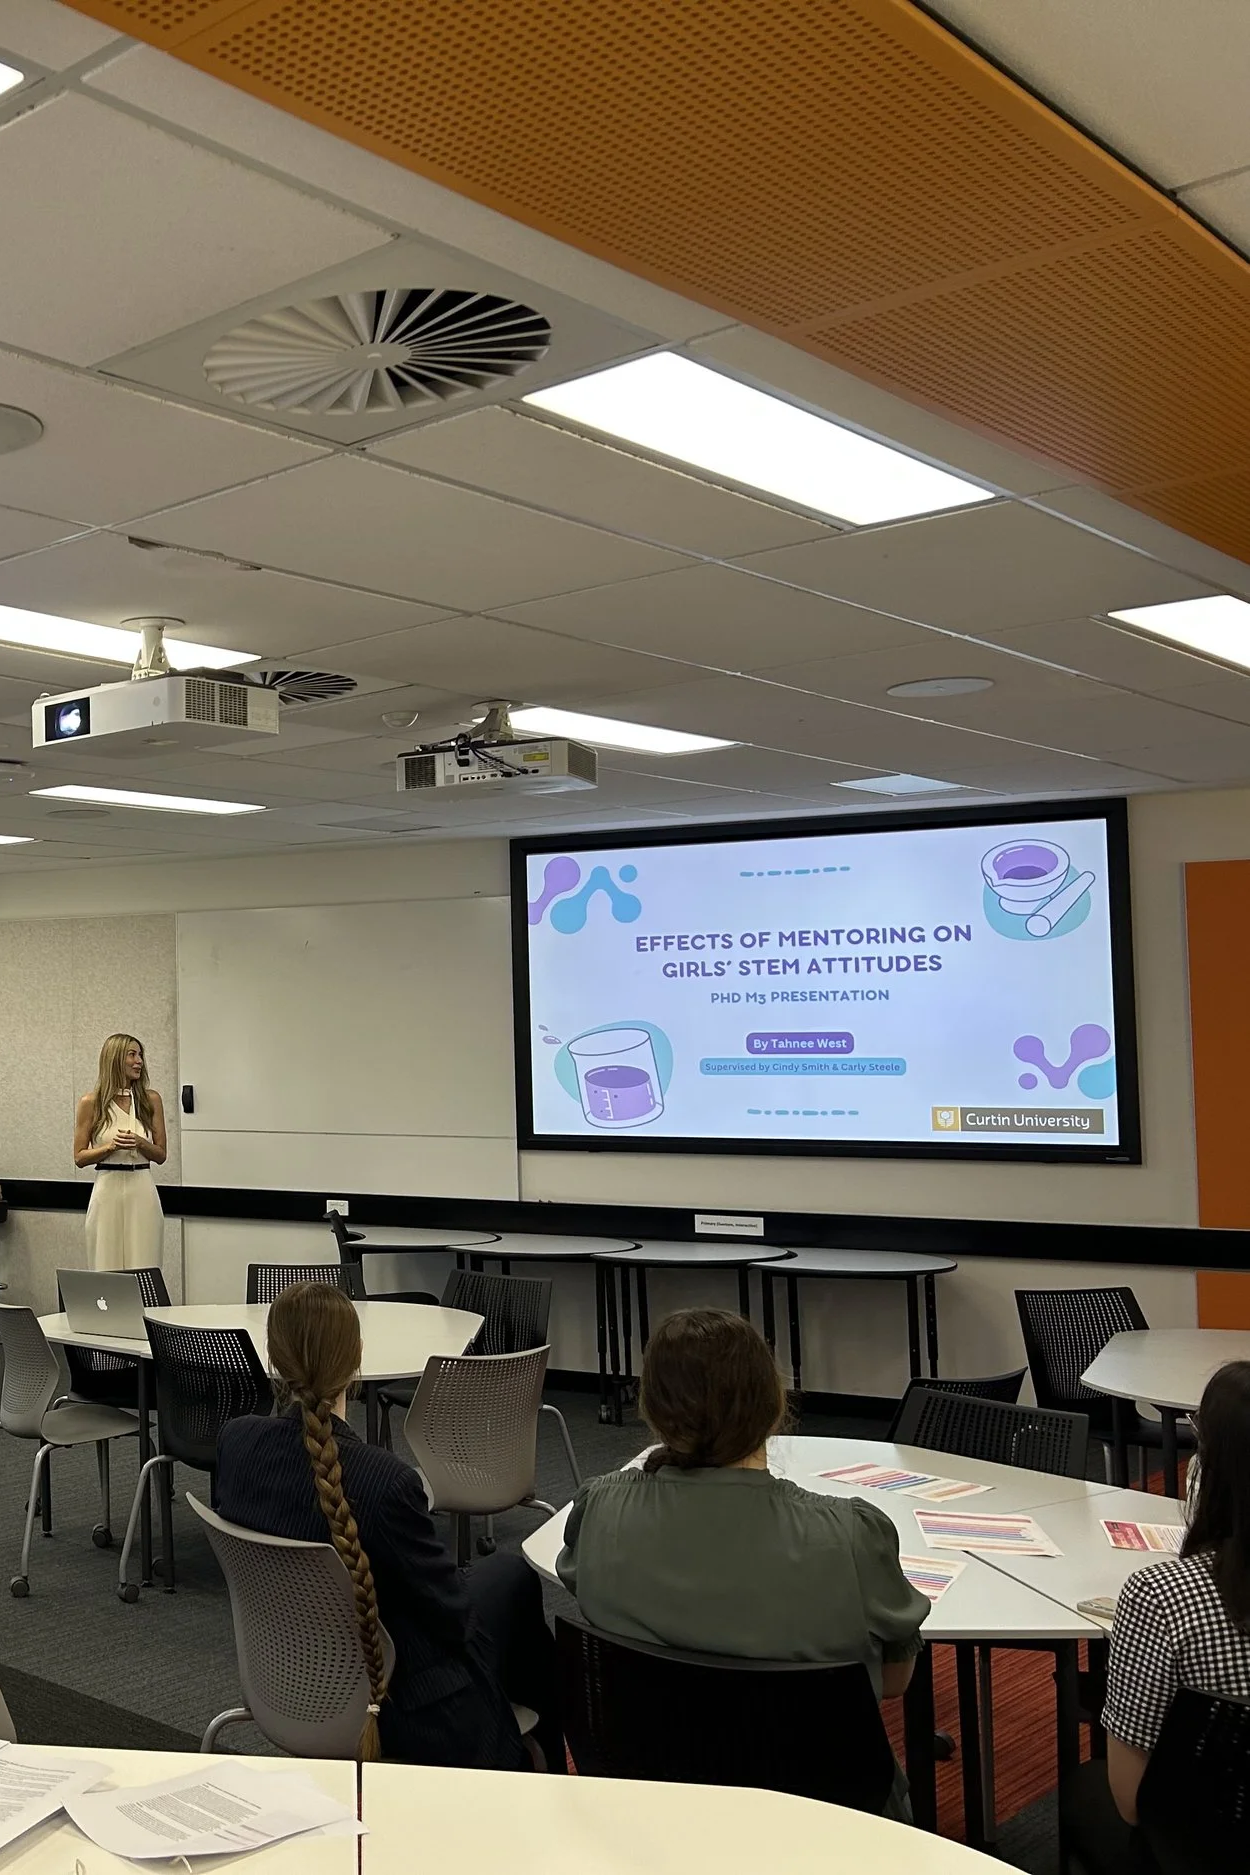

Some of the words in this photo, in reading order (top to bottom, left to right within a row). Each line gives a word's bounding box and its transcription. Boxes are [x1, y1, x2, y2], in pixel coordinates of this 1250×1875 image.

[635, 932, 734, 953] EFFECTS
[739, 931, 772, 949] OF
[778, 925, 926, 948] MENTORING
[933, 923, 972, 943] ON
[738, 957, 800, 977] STEM
[806, 954, 943, 976] ATTITUDES
[710, 991, 741, 1005] PHD
[745, 991, 767, 1006] M3
[770, 988, 890, 1004] PRESENTATION
[753, 1038, 769, 1051] By
[771, 1037, 815, 1049] Tahnee
[816, 1037, 847, 1049] West
[705, 1062, 756, 1073] Supervised
[758, 1062, 771, 1073] by
[772, 1062, 800, 1073] Cindy
[801, 1062, 830, 1072] Smith
[832, 1063, 840, 1072] &
[841, 1062, 867, 1073] Carly
[868, 1062, 901, 1072] Steele
[965, 1112, 1011, 1127] Curtin
[1013, 1112, 1091, 1130] University
